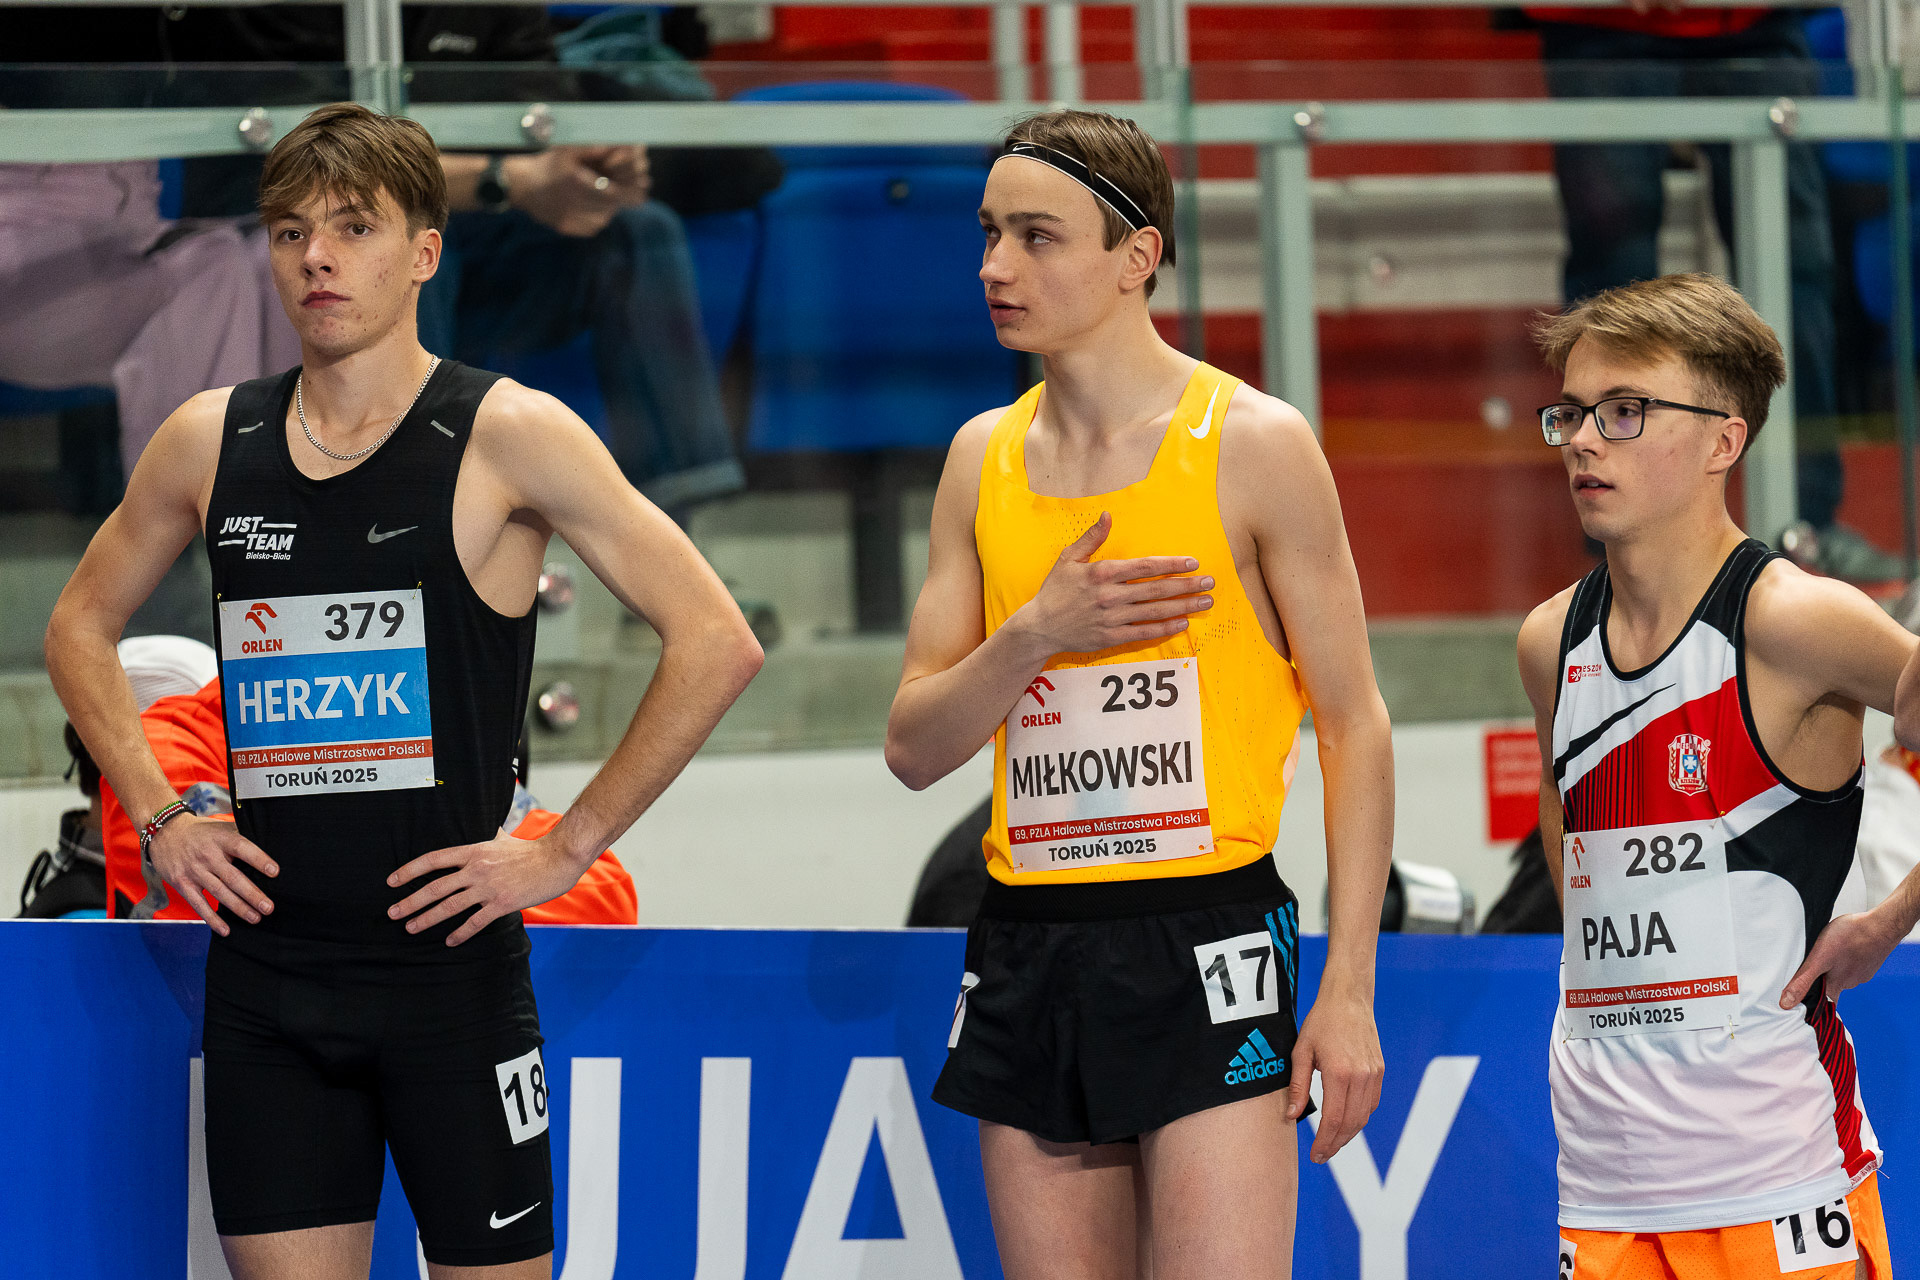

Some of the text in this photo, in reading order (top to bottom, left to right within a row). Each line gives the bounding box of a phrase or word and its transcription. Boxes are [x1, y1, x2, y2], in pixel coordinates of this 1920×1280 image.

[220, 516, 264, 534] JUST
[246, 533, 294, 551] TEAM
[324, 600, 405, 641] 379
[241, 638, 283, 655] ORLEN
[238, 671, 411, 724] HERZYK
[1100, 669, 1179, 713] 235
[1021, 711, 1062, 728] ORLEN
[237, 742, 425, 766] 69. PZLA Halowe Mistrzostwa Polski
[266, 766, 379, 788] TORUŃ 2025
[1012, 740, 1193, 800] MIŁKOWSKI
[1015, 812, 1201, 841] 69. PZLA Halowe Mistrzostwa Polski
[1048, 838, 1157, 862] TORUŃ 2025
[1623, 832, 1706, 877] 282
[1570, 874, 1591, 889] ORLEN
[1581, 911, 1677, 961] PAJA
[1204, 945, 1271, 1007] 17
[1590, 991, 1624, 1003] Halowe
[1625, 985, 1691, 1000] Mistrzostwa
[1693, 979, 1730, 994] Polski
[1588, 1006, 1685, 1029] TORUŃ 2025
[1224, 1057, 1285, 1085] adidas
[504, 1063, 546, 1126] 18
[1774, 1198, 1851, 1255] 16
